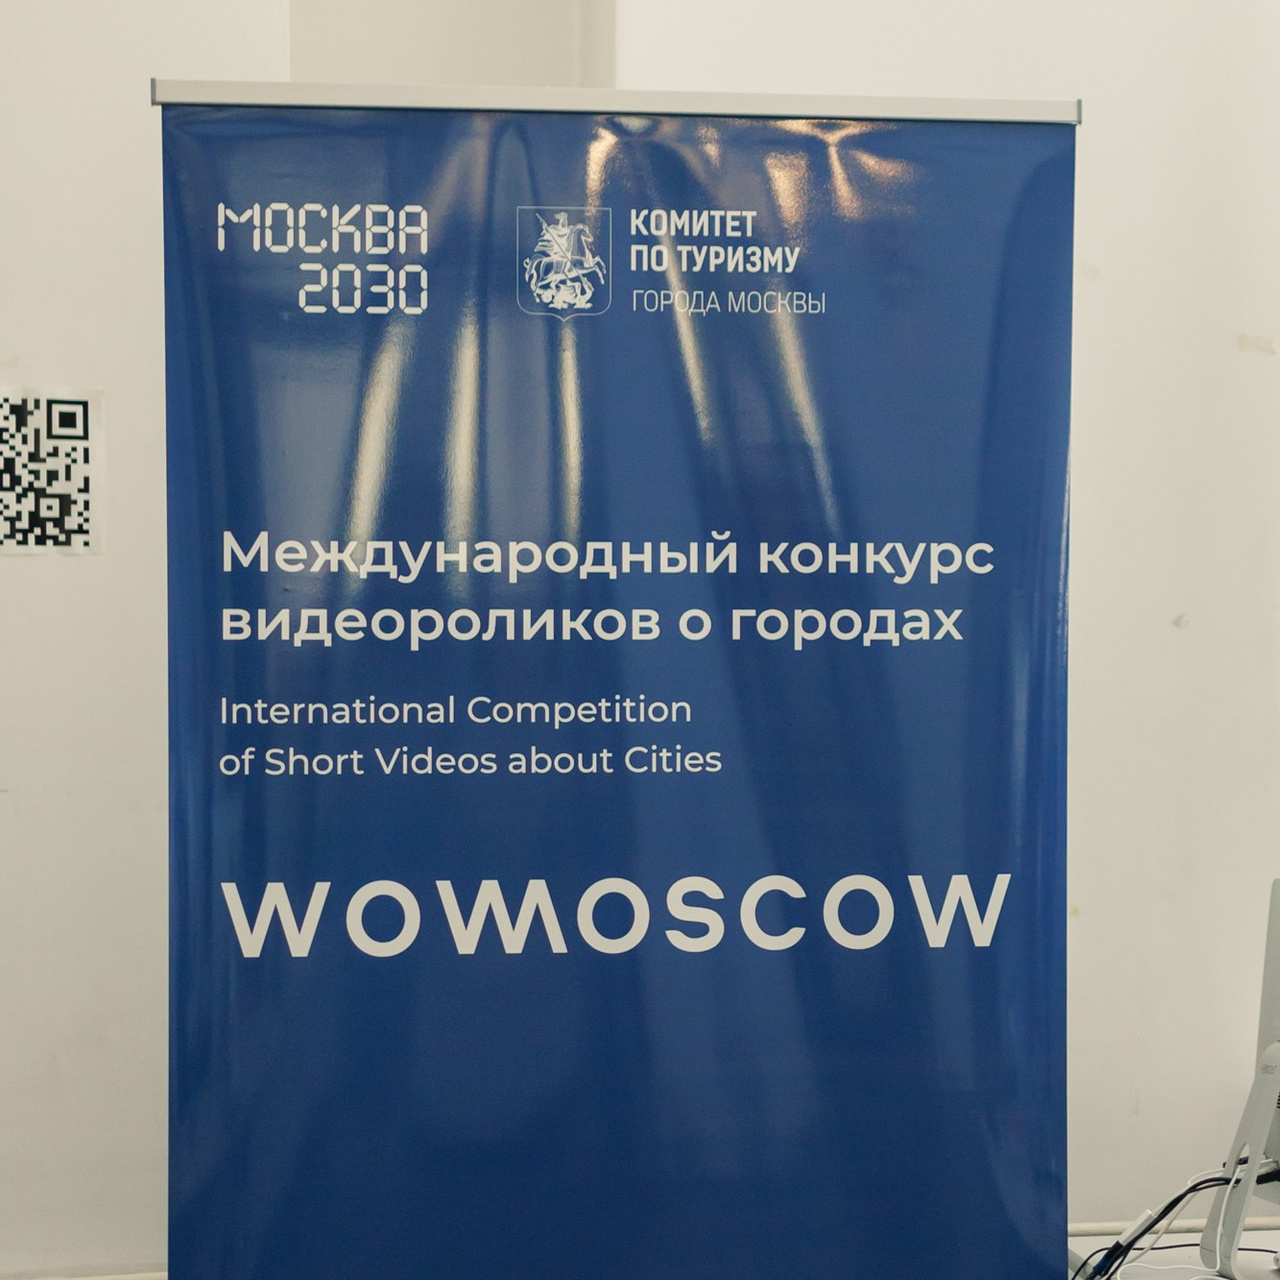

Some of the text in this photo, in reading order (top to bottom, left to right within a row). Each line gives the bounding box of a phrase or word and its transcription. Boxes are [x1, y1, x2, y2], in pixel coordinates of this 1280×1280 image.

[217, 202, 428, 254] МОСКВА
[630, 208, 757, 237] КОМИТЕТ
[630, 245, 800, 273] ПО ТУРИЗМУ
[299, 263, 428, 314] 2030
[632, 289, 826, 317] ГОРОДА МОСКВЫ
[222, 531, 994, 584] Международный конкурс
[221, 608, 964, 651] видеороликов о городах
[220, 694, 692, 729] International Competition
[219, 744, 722, 776] of Short Videos about Cities
